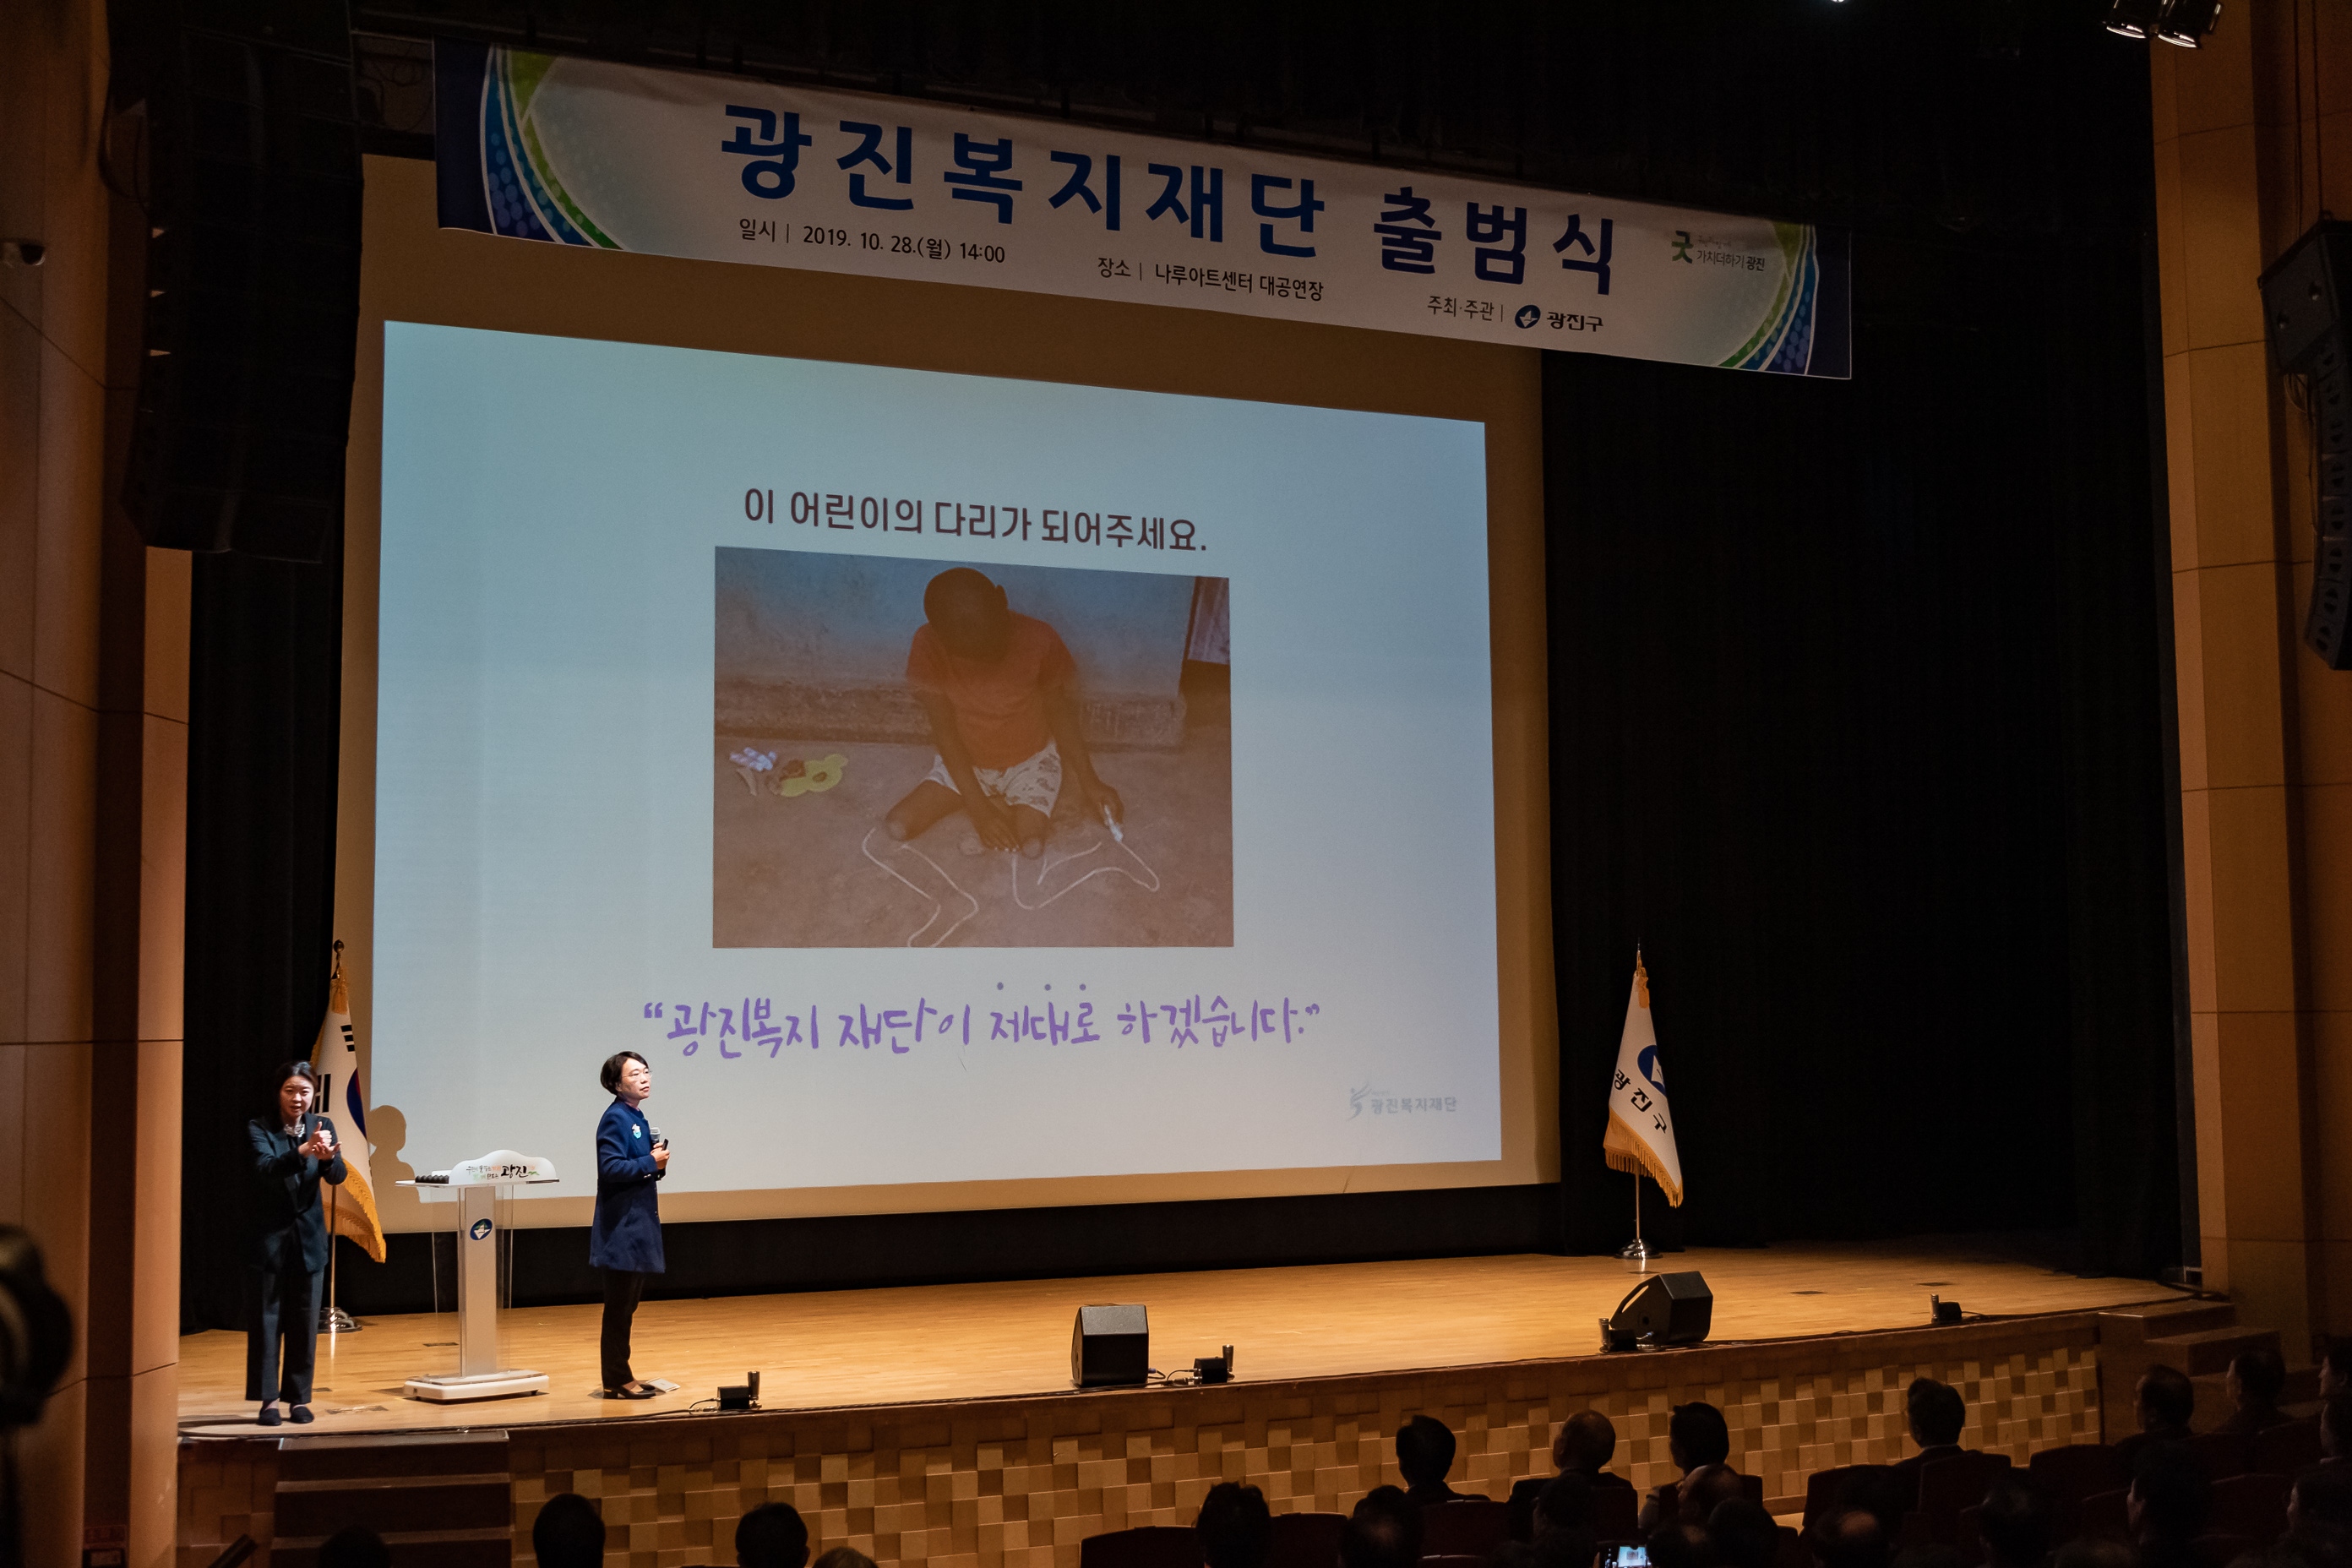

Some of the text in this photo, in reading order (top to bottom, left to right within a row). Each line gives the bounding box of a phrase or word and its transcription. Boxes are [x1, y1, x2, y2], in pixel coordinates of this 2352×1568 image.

[721, 104, 1614, 296] 광진복지재단 출범식
[739, 218, 1005, 264] 일시 2019. 10. 28.(월) 14:00
[1697, 250, 1766, 272] 가치더하기 광진
[1097, 257, 1324, 302] 장소 나루아트센터 대공연장
[1547, 312, 1603, 332] 광진구
[744, 488, 1206, 551] 이 어린이의 다리가 되어주세요.
[839, 997, 972, 1054] 재단이
[990, 1001, 1100, 1046] 제대로
[1370, 1096, 1458, 1115] 광진복지재단
[1614, 1069, 1668, 1134] 광진구
[500, 1164, 529, 1179] 광진
